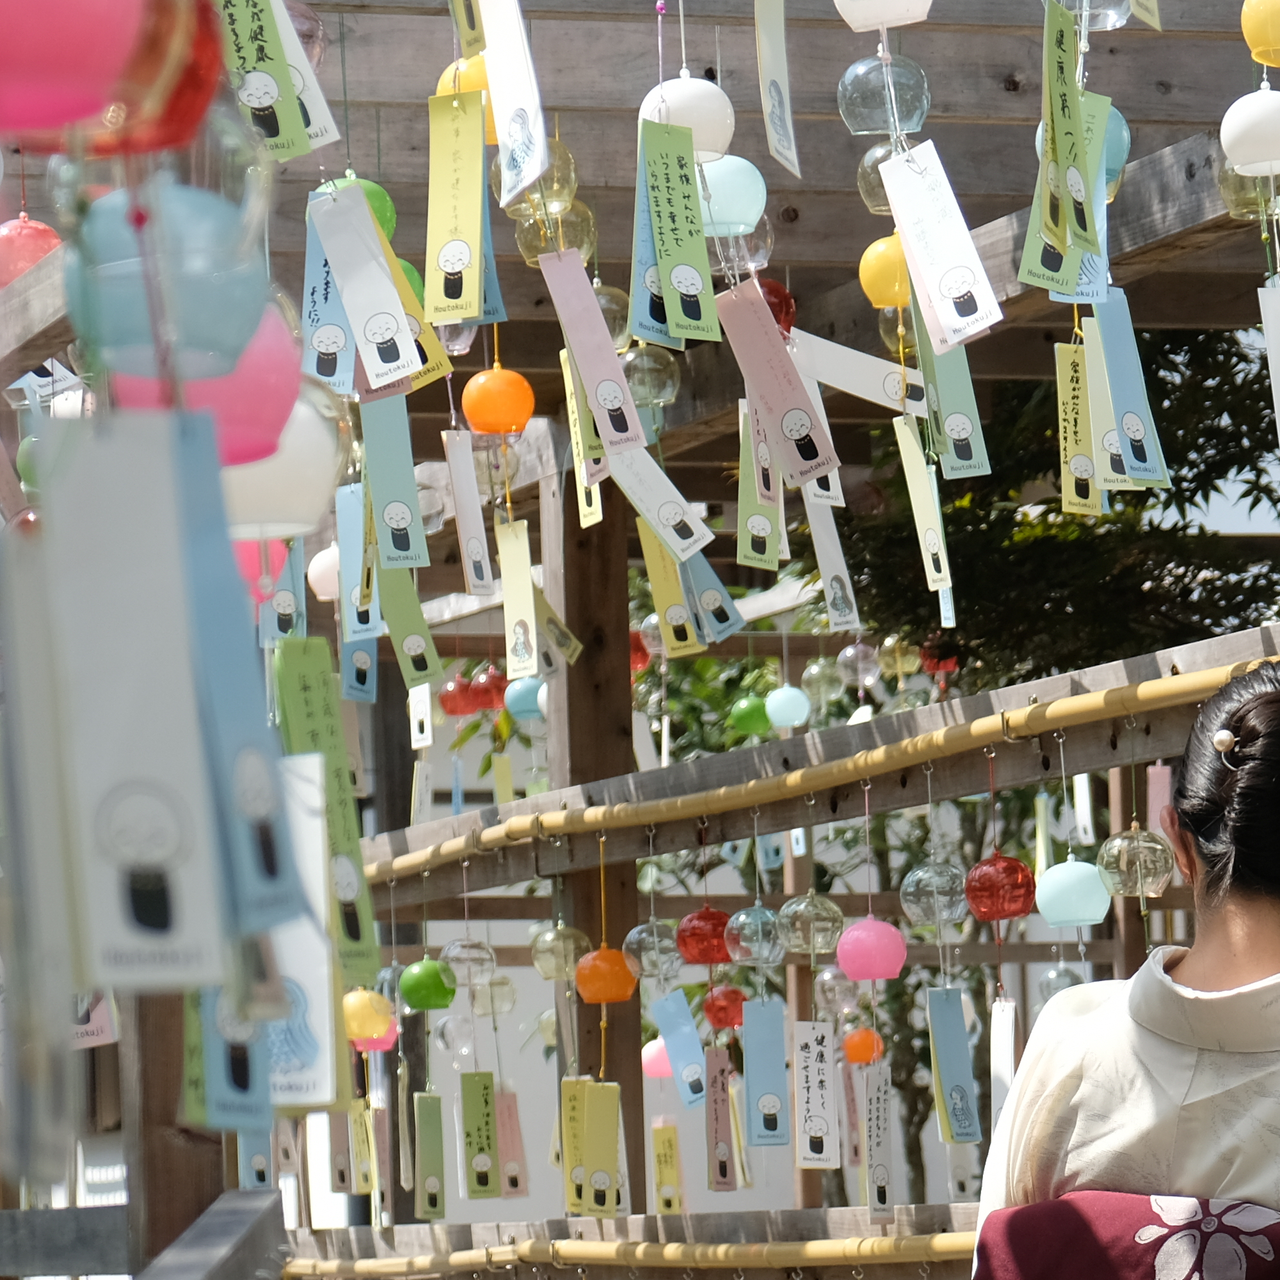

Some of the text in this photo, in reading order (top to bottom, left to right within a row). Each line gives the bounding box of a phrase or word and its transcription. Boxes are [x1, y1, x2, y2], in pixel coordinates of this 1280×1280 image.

[659, 152, 683, 249] いつまでも幸せで
[676, 154, 701, 238] 家族みんなが
[648, 159, 672, 260] いられますように
[1026, 268, 1070, 287] Houtokuji
[433, 300, 472, 314] Houtokuji
[638, 321, 670, 337] Houtoku
[675, 321, 714, 334] Houtokuji
[952, 311, 993, 336] Houtokuji
[374, 358, 414, 379] Houtokuji
[410, 361, 444, 383] outokuji
[608, 434, 641, 448] Houtokuji
[799, 455, 833, 478] Houtokuji
[947, 461, 986, 474] Houtokuji
[1130, 465, 1158, 474] Houtokuji
[387, 553, 421, 563] Houtokuji
[814, 1032, 828, 1111] 健康に楽しく
[272, 1081, 318, 1094] tokuji
[799, 1042, 814, 1124] 過ごせますように
